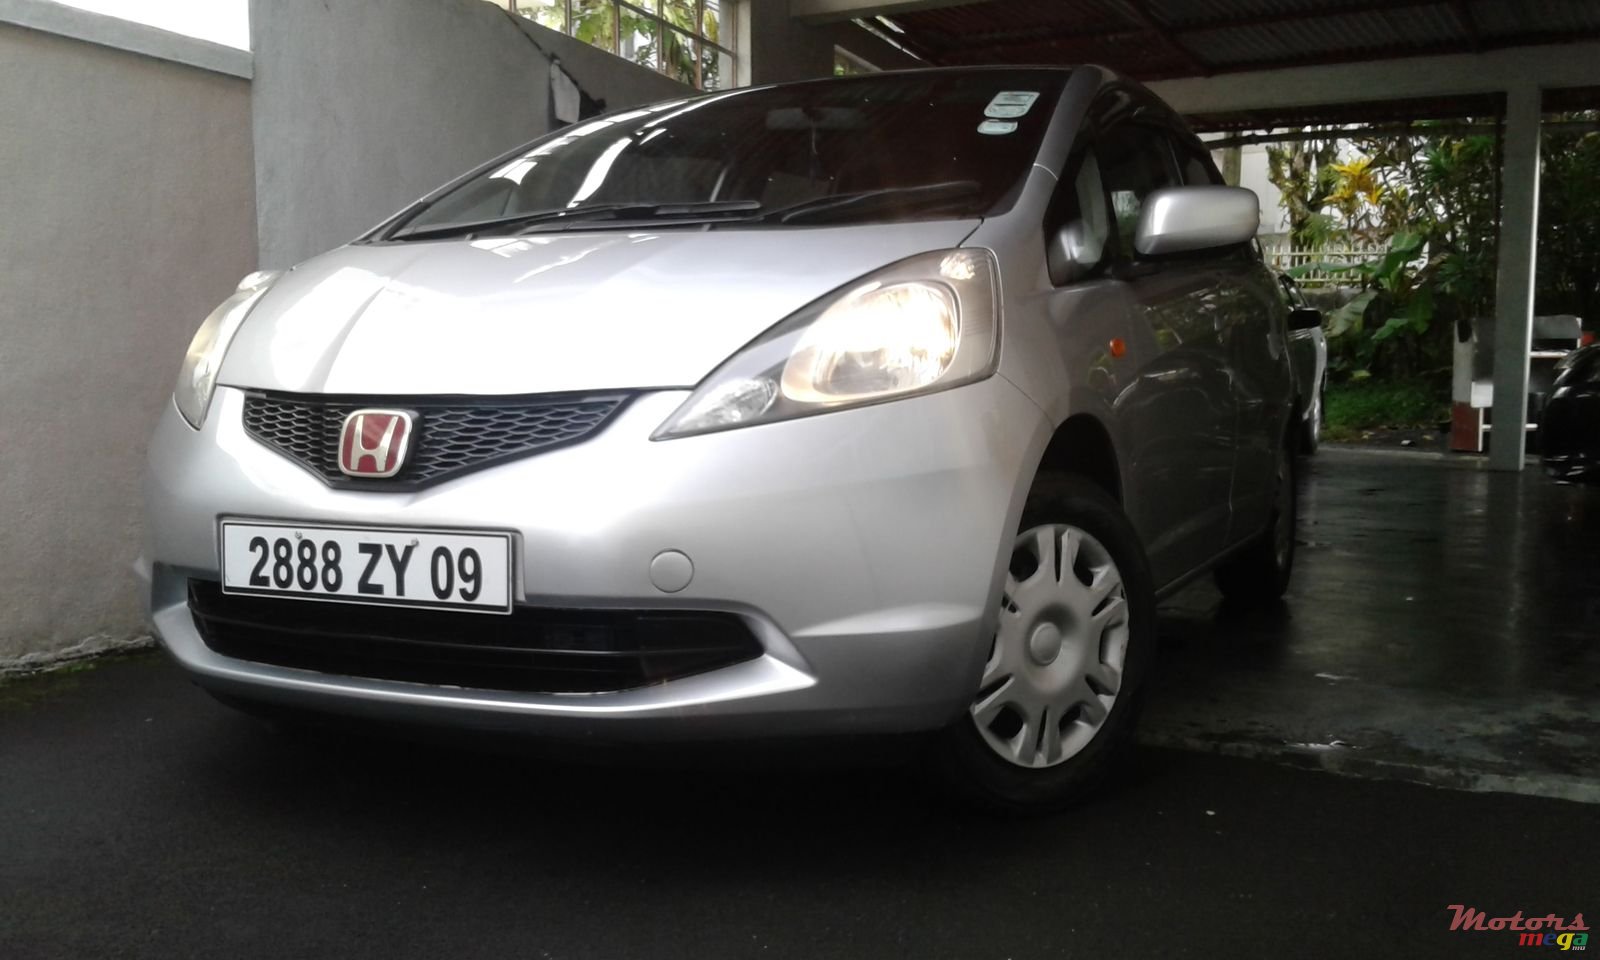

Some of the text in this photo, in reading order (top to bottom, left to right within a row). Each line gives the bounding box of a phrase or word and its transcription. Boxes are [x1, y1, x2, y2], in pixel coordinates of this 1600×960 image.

[249, 536, 482, 602] 2888 ZY 09
